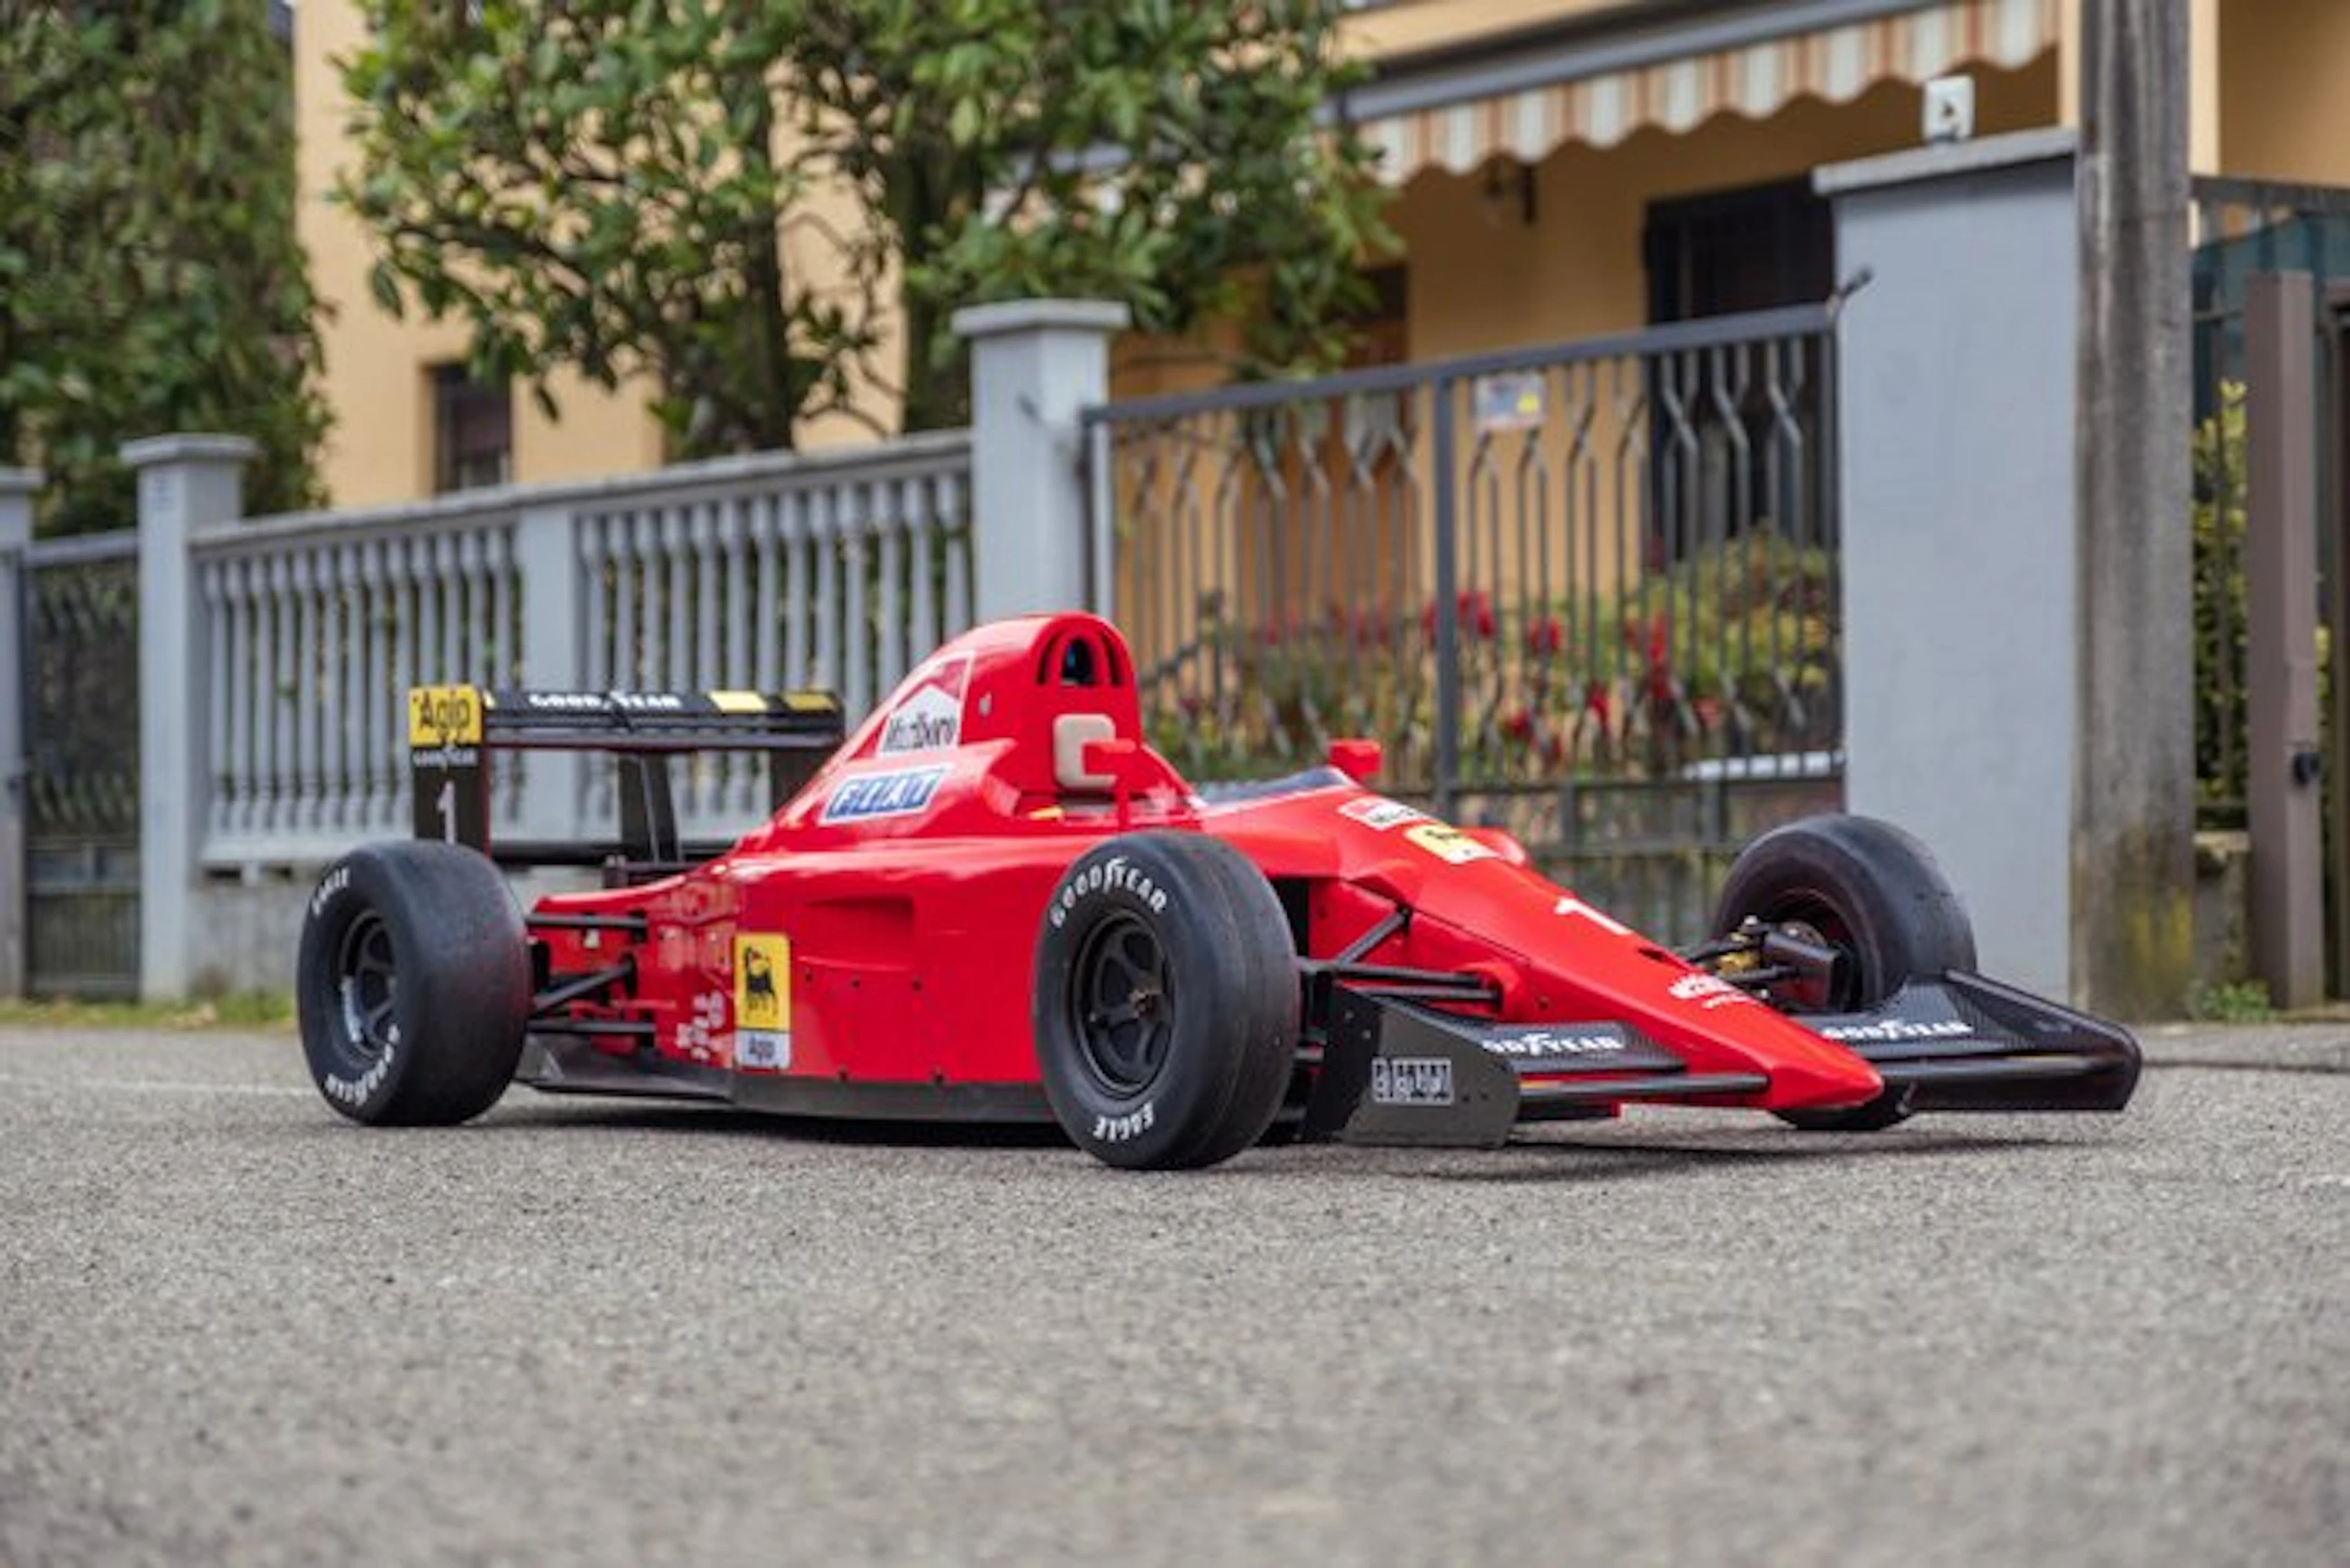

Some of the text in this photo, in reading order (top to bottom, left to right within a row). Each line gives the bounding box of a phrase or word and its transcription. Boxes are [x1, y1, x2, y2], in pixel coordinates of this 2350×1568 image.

[437, 779, 456, 846] 1
[1049, 856, 1168, 929] GOODYEAR
[1092, 1100, 1154, 1143] EAGLE
